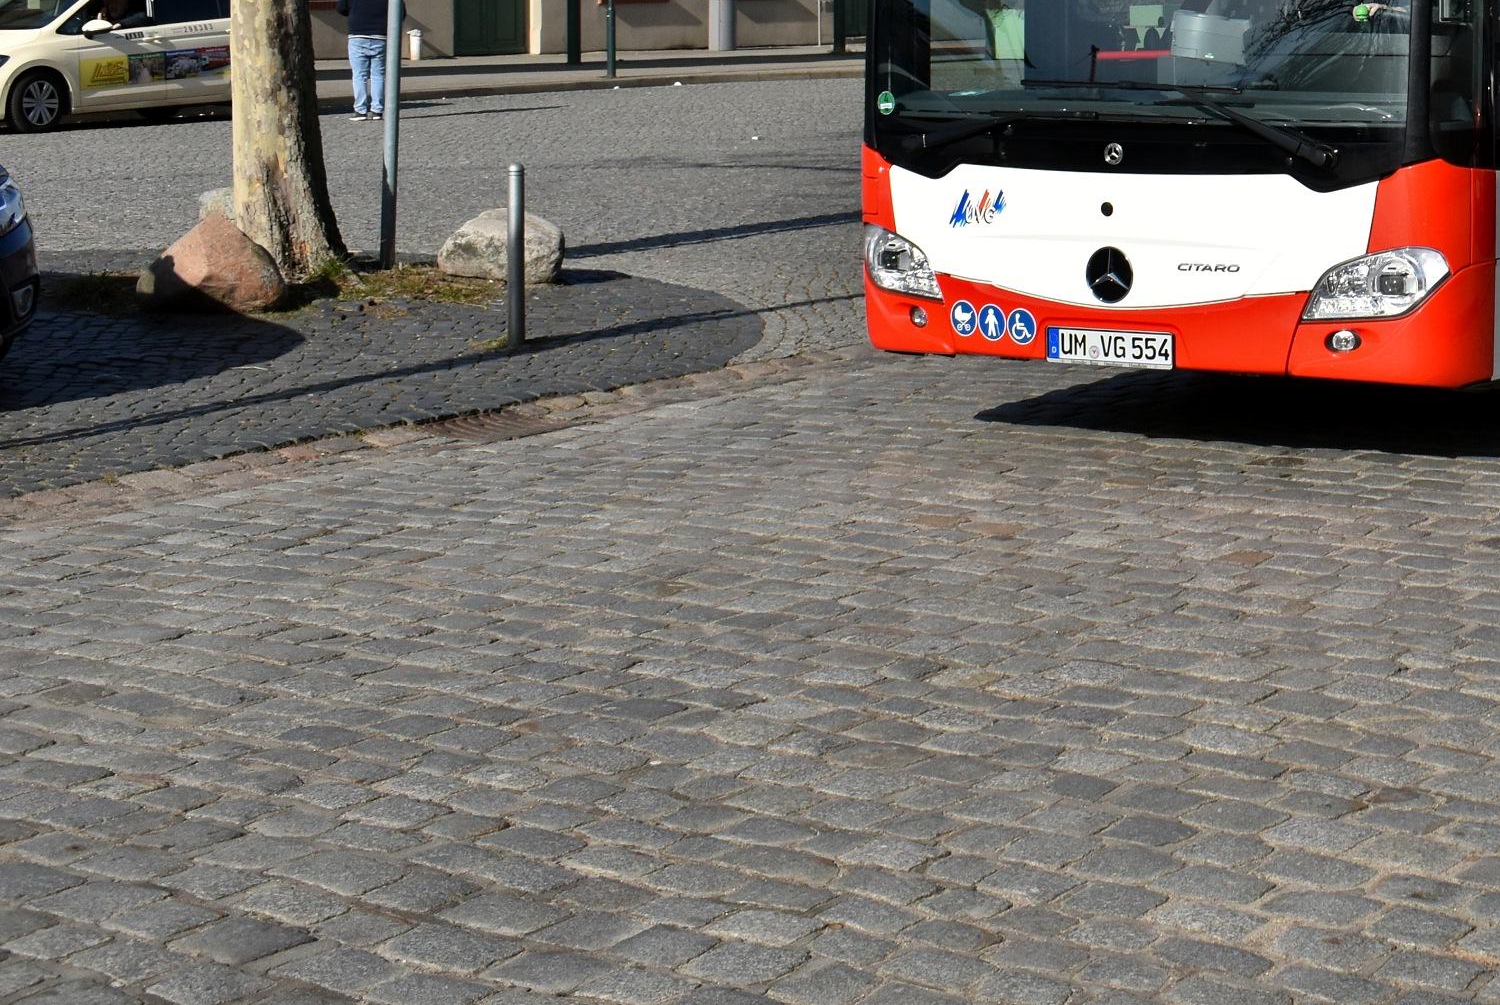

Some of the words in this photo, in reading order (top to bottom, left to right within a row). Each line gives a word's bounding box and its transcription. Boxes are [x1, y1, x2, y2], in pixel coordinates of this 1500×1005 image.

[1177, 262, 1241, 273] CITARO
[1060, 332, 1087, 356] UM
[1100, 335, 1126, 359] VG
[1131, 338, 1170, 361] 554
